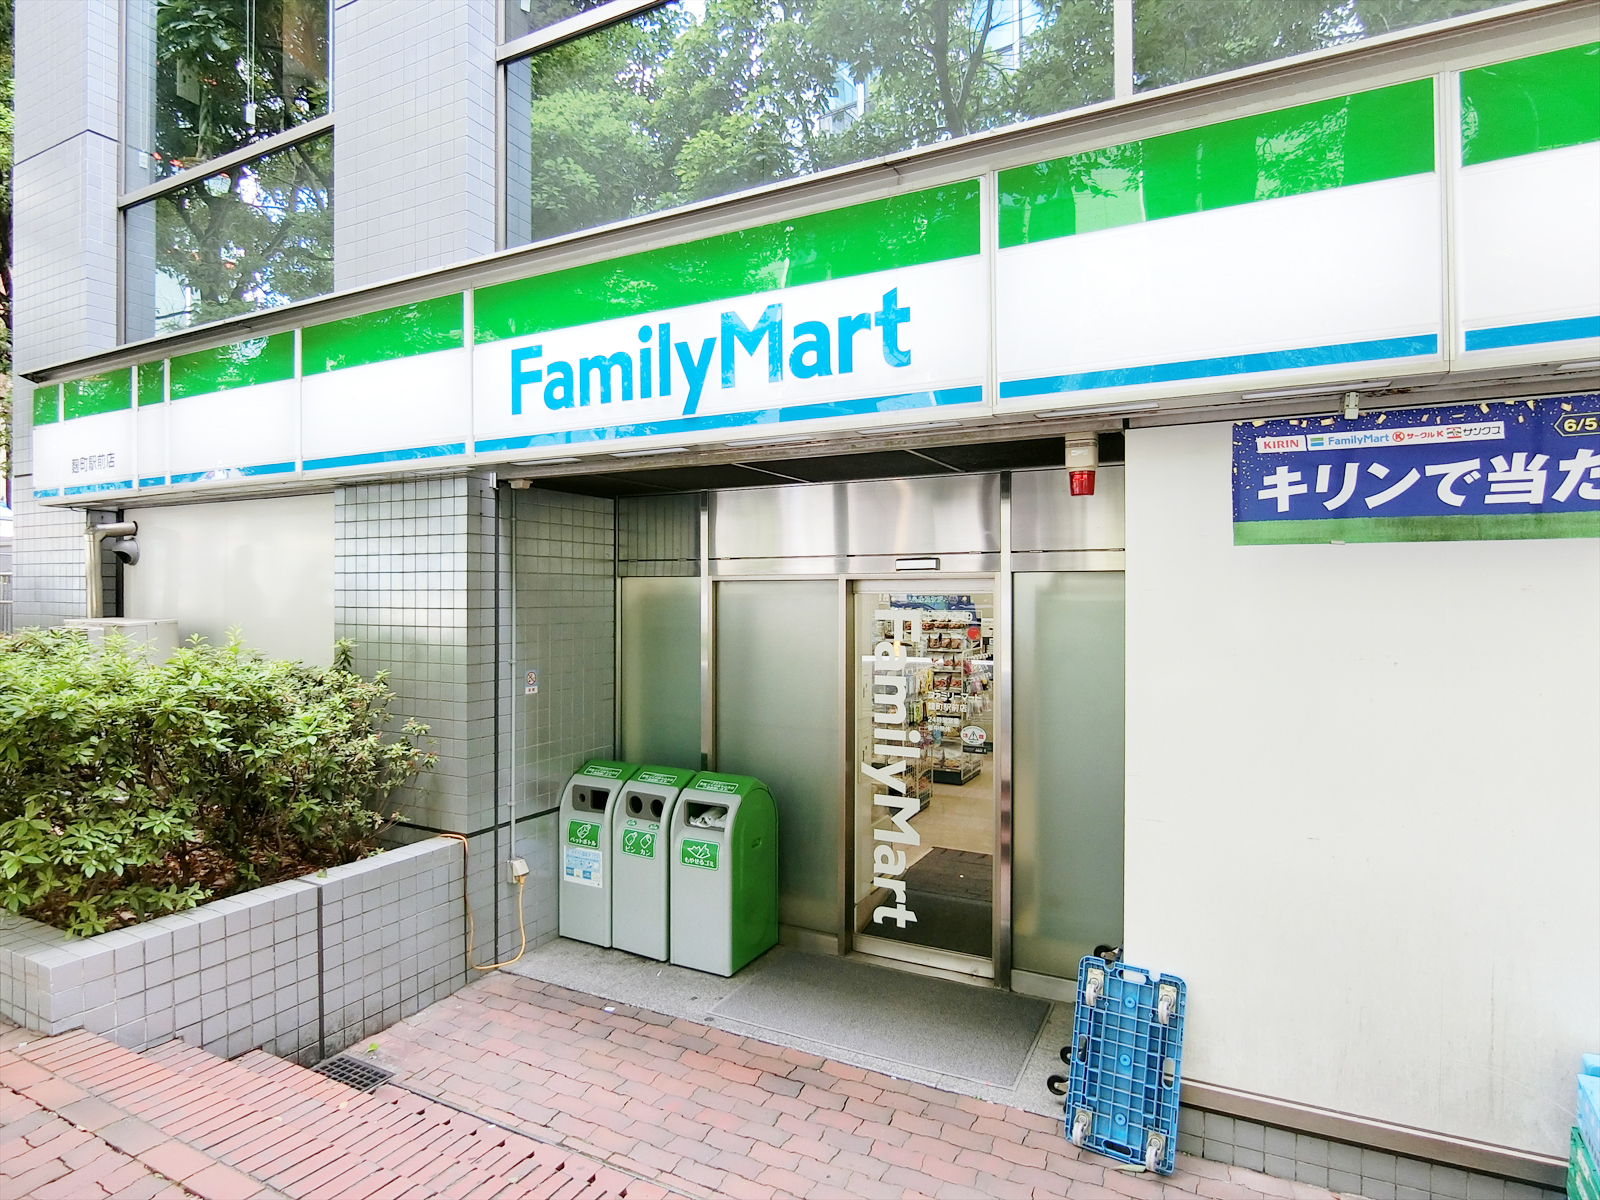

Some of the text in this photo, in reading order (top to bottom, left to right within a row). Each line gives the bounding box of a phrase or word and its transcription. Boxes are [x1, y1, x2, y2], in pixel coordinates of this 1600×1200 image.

[511, 287, 911, 416] FamilyMart
[1263, 439, 1299, 450] KIRIN
[1328, 433, 1389, 446] FamilyMart
[1463, 425, 1501, 436] サンクス
[928, 690, 982, 702] ファミリーマート
[861, 609, 920, 928] FamilyMart
[570, 837, 597, 847] ペットボトル
[684, 856, 714, 868] もやせるゴミ
